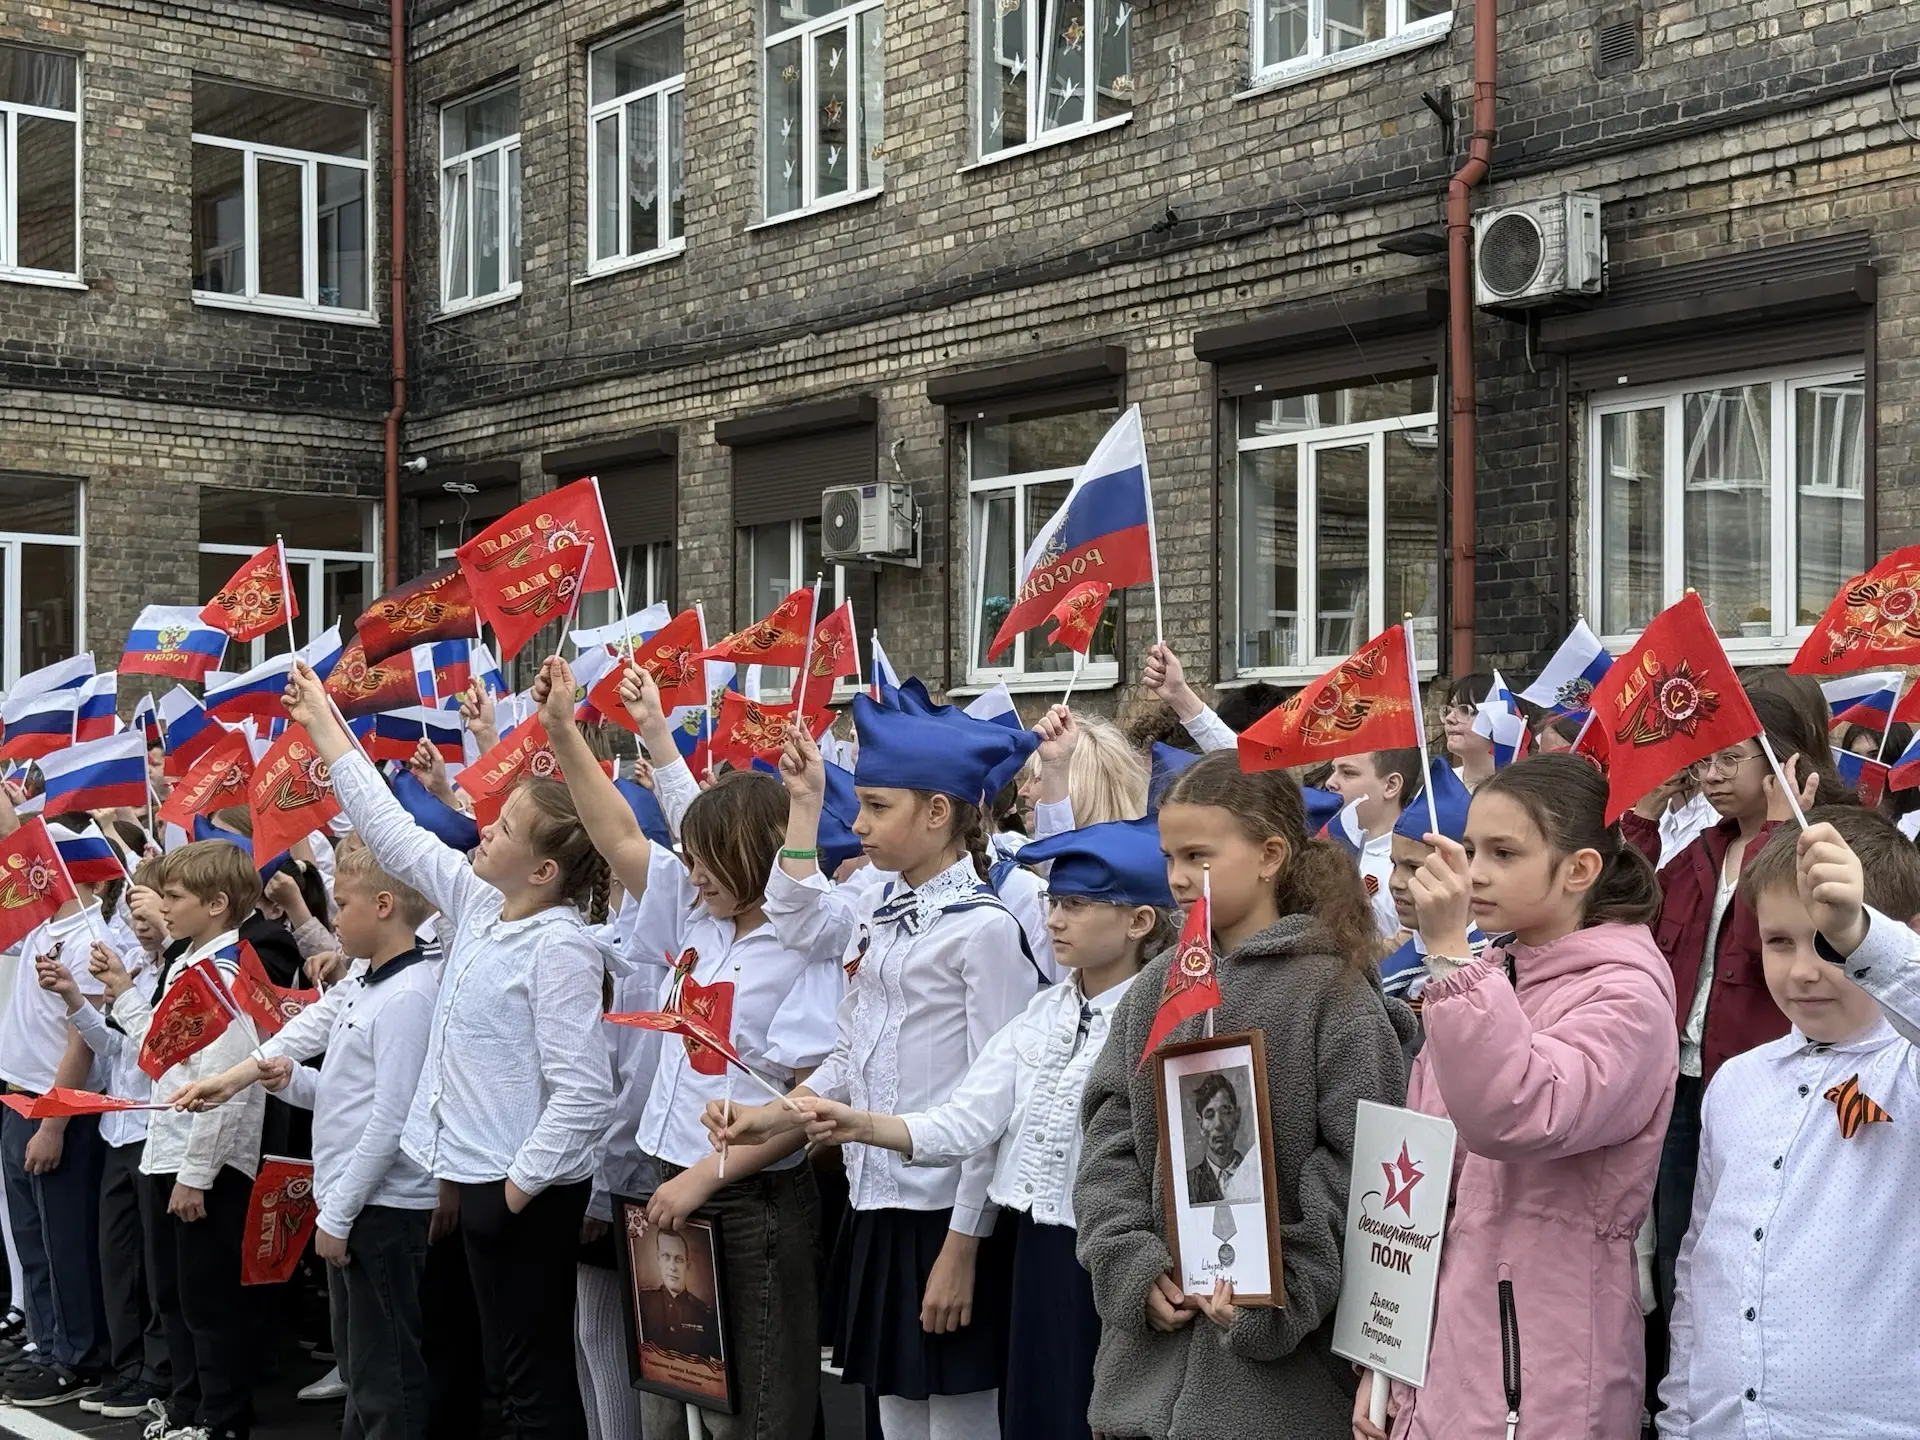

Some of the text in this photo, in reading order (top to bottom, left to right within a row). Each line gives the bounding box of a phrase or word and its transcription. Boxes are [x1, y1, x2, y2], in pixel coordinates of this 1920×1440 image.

[1371, 1241, 1414, 1276] ПОЛК
[1370, 1291, 1400, 1314] Дьяков
[1372, 1309, 1394, 1329] Иван
[1361, 1321, 1402, 1349] Петрович
